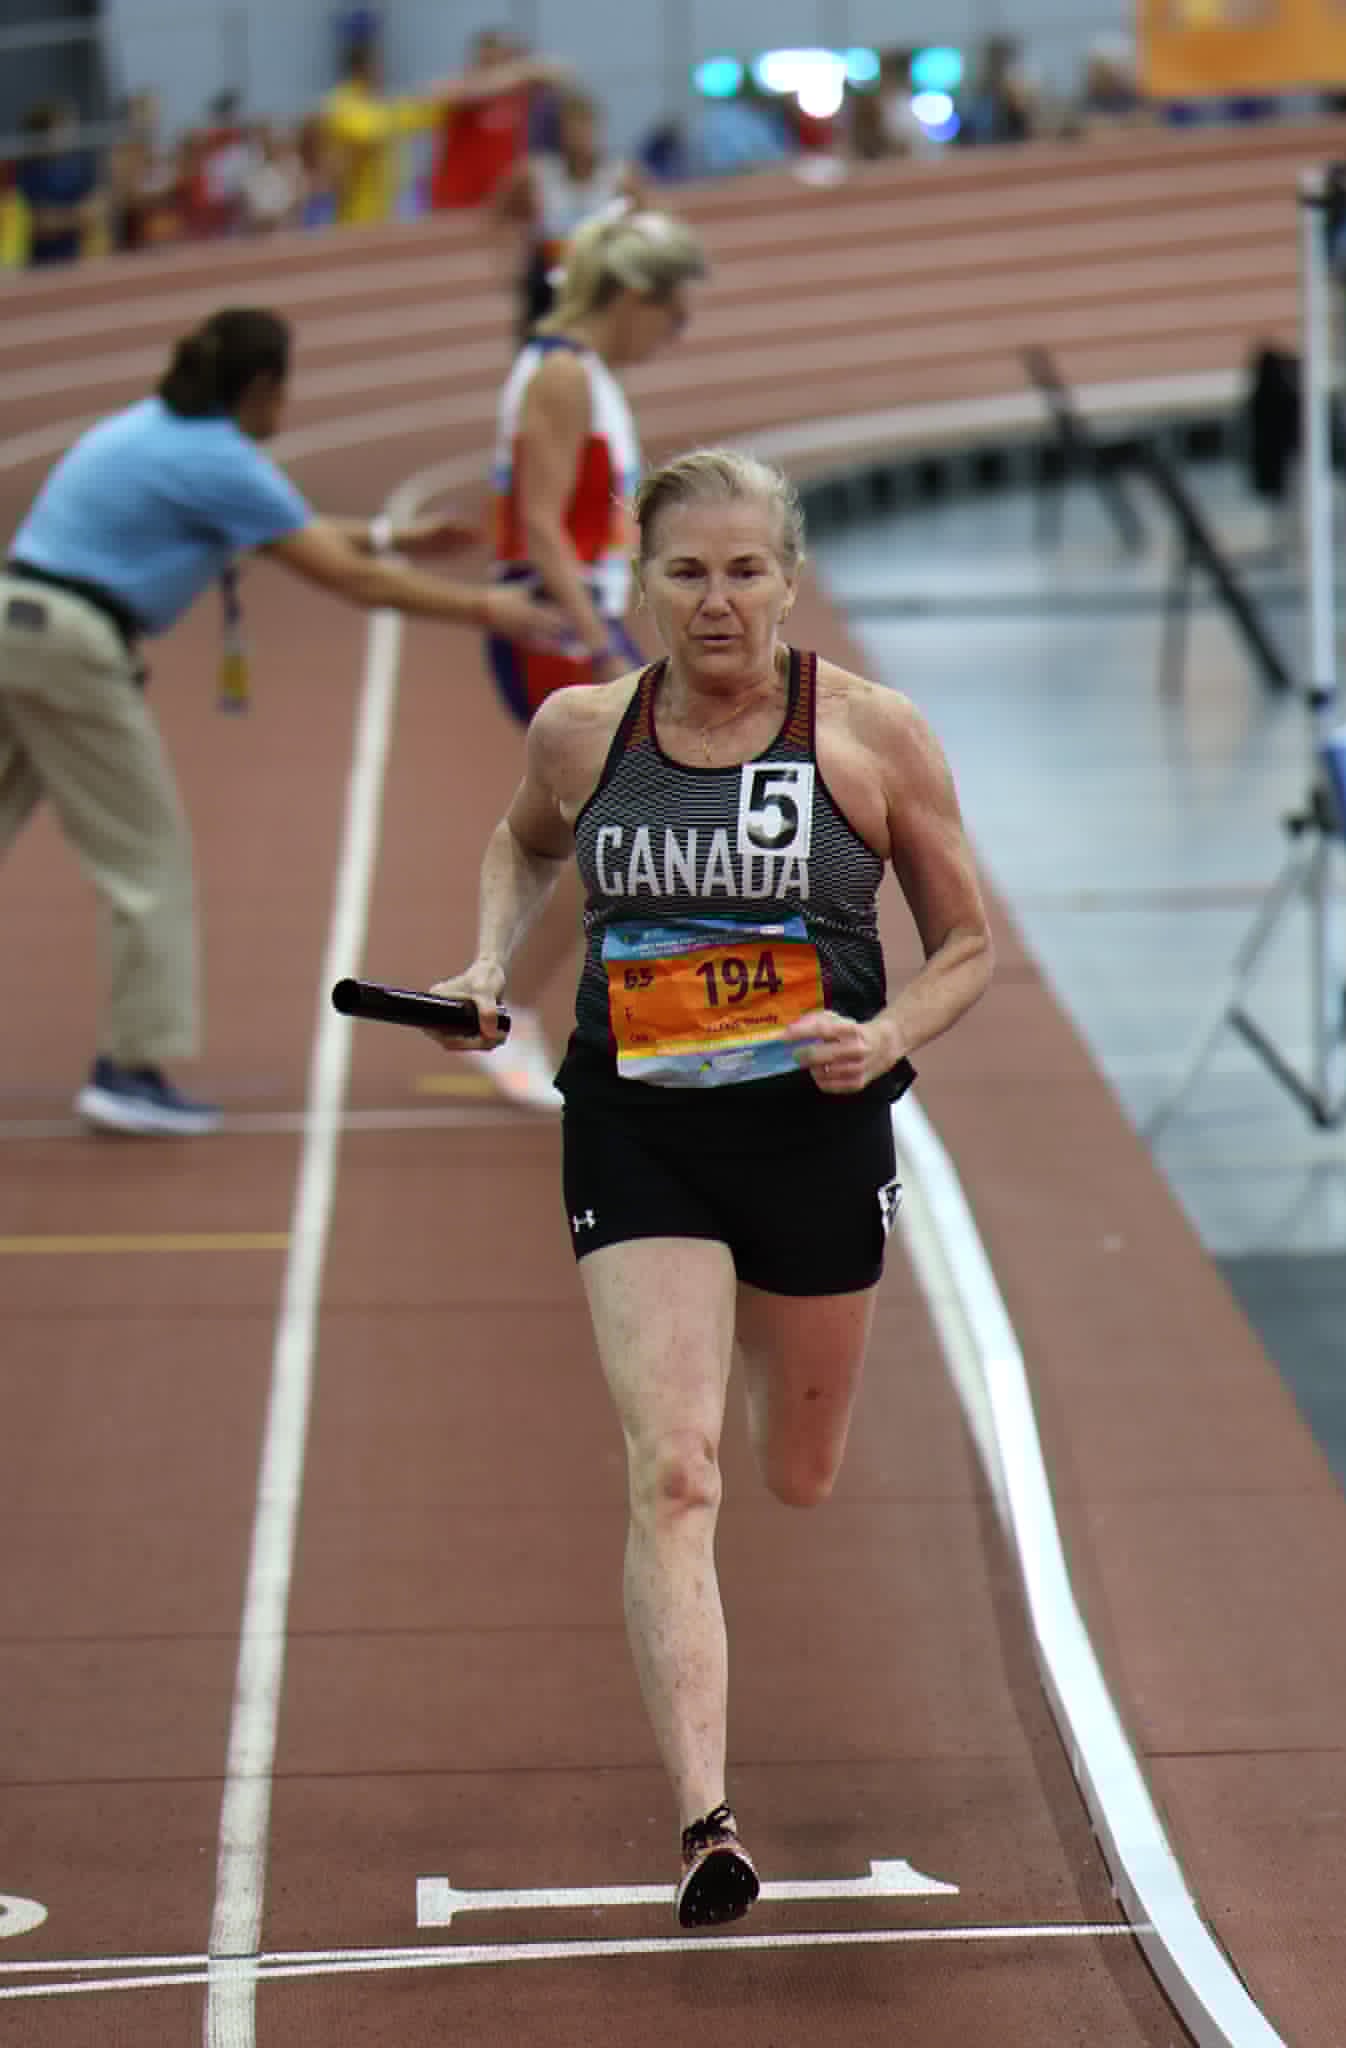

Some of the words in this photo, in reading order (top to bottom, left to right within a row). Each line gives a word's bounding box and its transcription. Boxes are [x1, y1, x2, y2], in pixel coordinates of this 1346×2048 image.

[746, 769, 800, 850] 5
[597, 825, 810, 899] CANADA
[696, 951, 783, 1007] 194
[416, 1859, 960, 1927] 1
